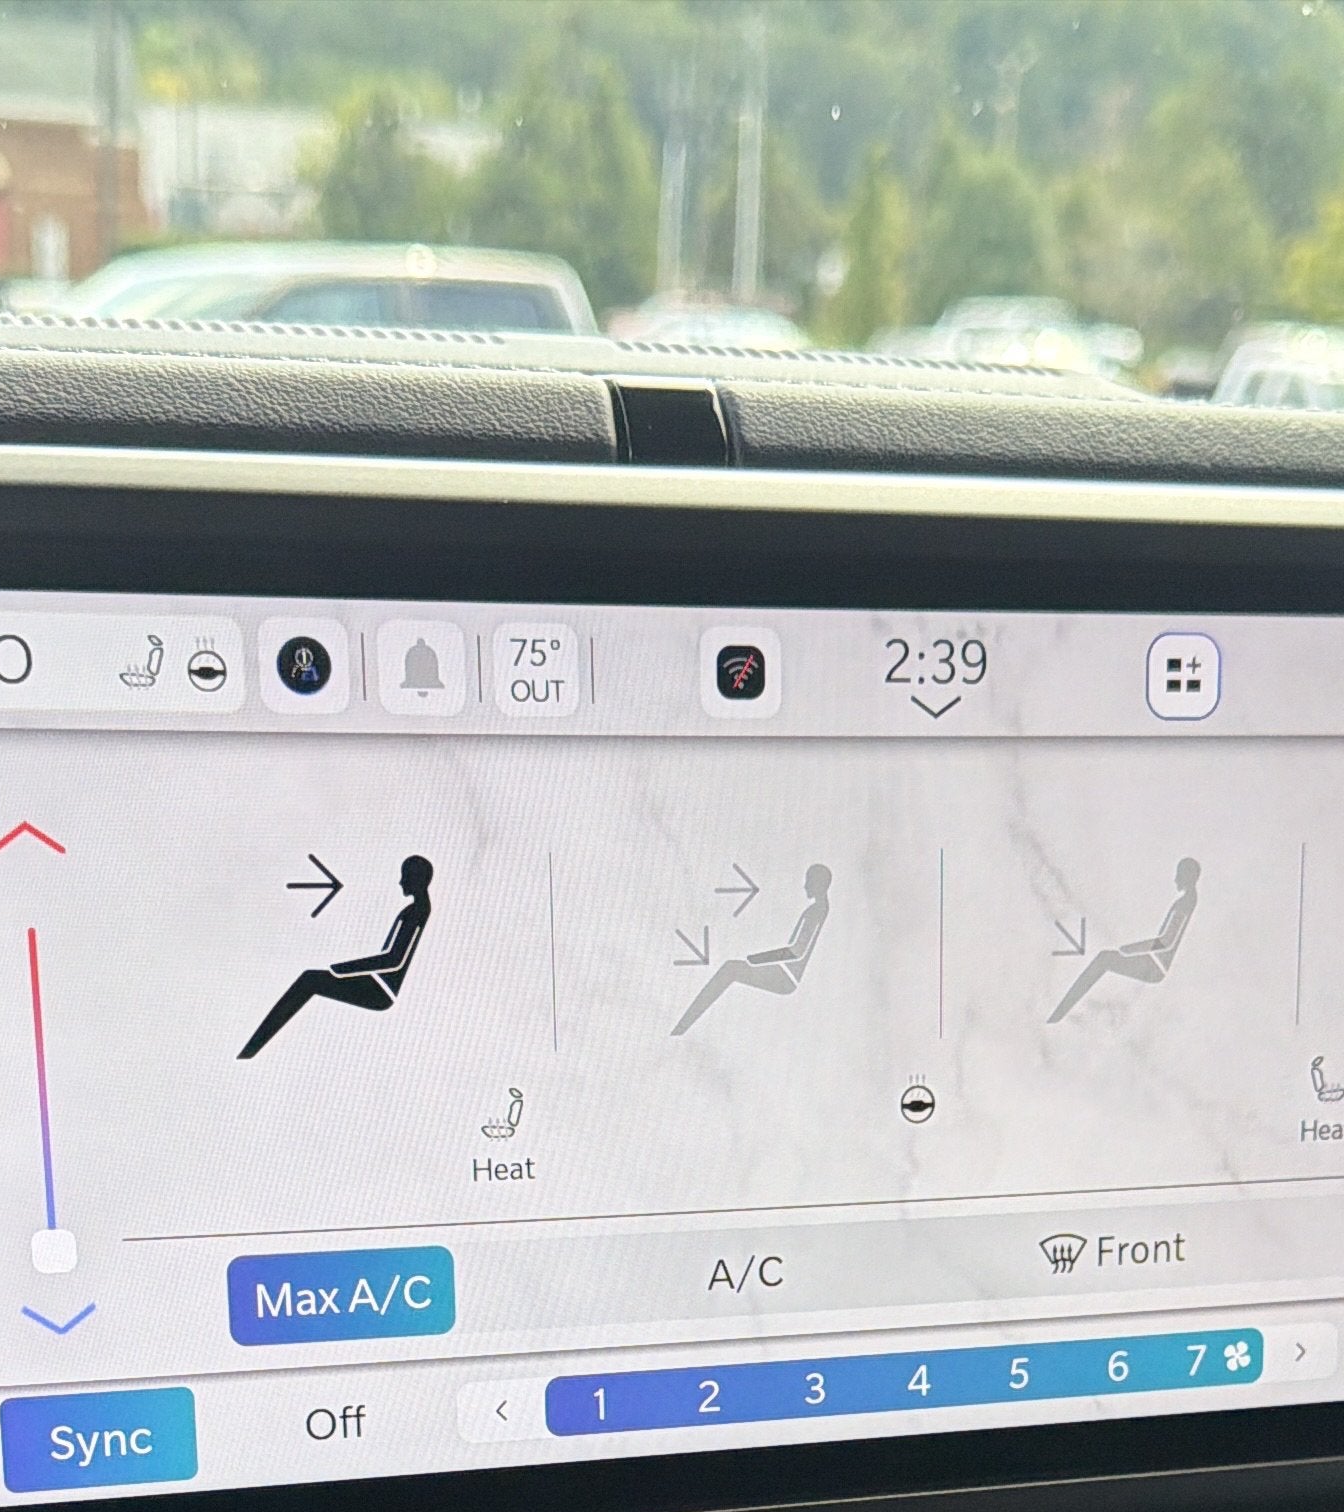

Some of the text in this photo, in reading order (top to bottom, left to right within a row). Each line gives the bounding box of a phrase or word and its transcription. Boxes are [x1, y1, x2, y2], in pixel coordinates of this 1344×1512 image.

[884, 638, 988, 686] 2:39
[510, 679, 565, 705] OUT
[471, 1155, 536, 1184] Heat
[1097, 1231, 1186, 1266] Front
[708, 1255, 785, 1292] A/C
[256, 1273, 433, 1318] Max A/C
[592, 1343, 1208, 1420] 1 2 3 4 5 6 7
[49, 1422, 154, 1461] Sync
[305, 1405, 367, 1441] Off
